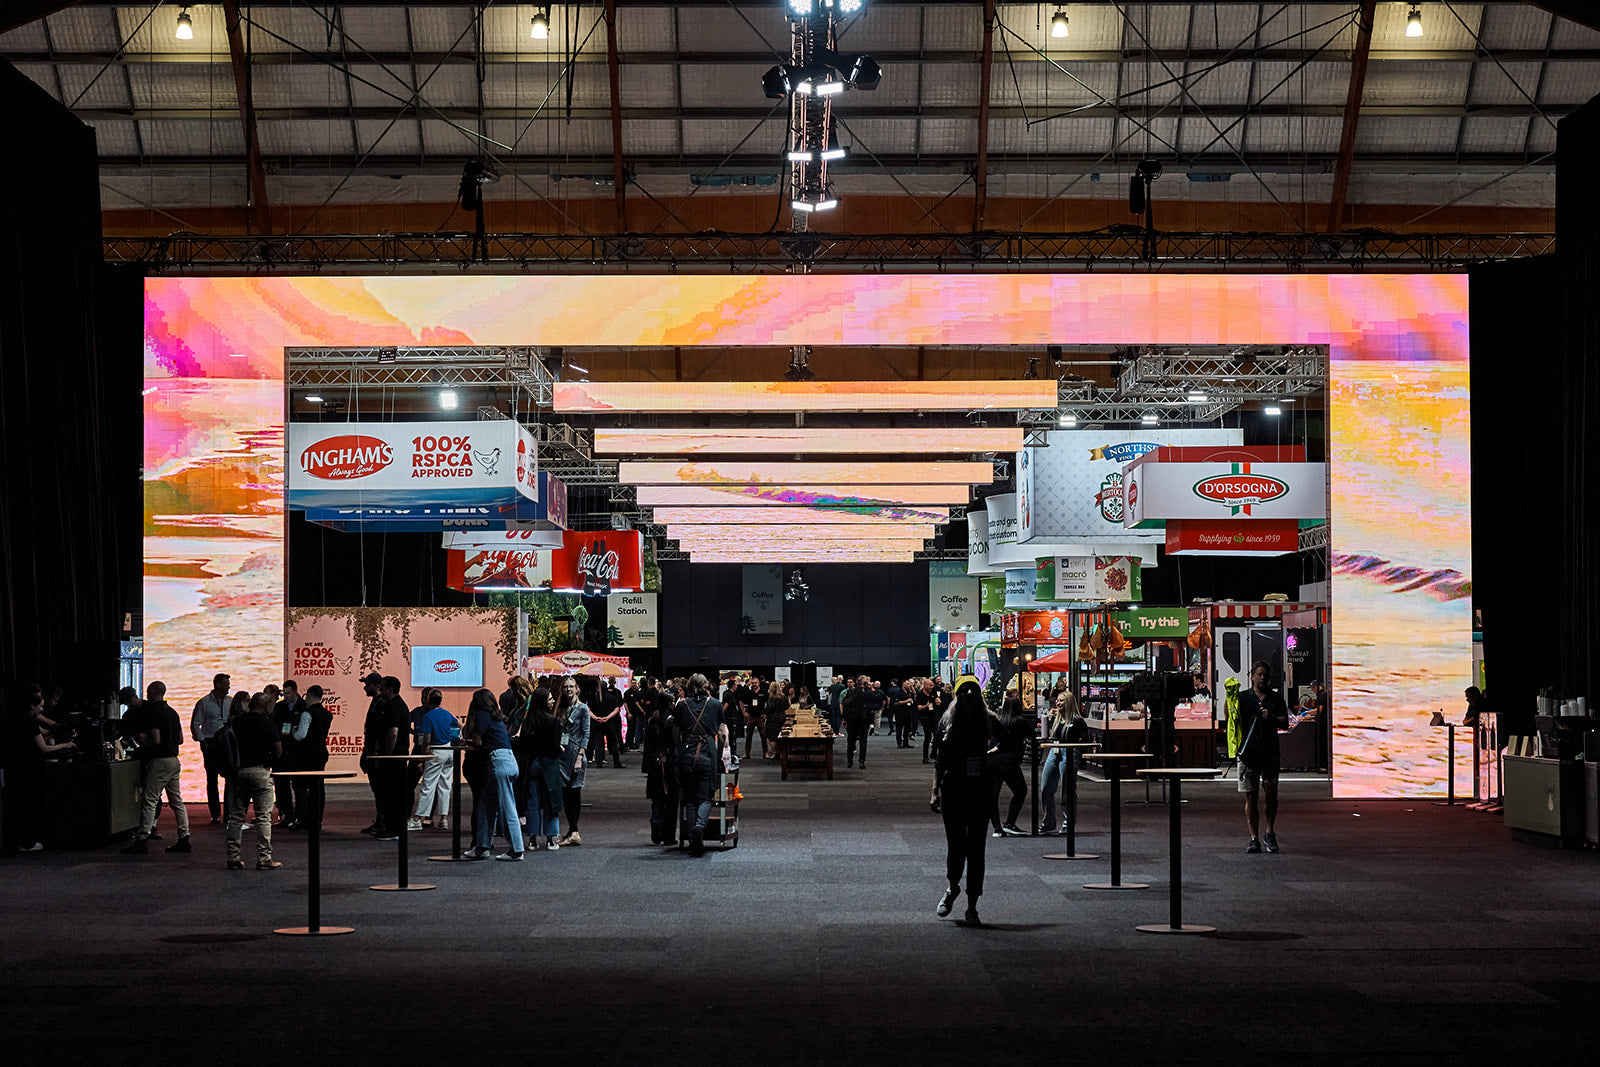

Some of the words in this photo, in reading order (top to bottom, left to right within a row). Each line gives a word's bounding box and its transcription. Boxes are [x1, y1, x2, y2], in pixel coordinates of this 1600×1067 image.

[412, 436, 472, 452] 100%
[303, 443, 394, 472] INGHAM'S
[412, 453, 473, 467] RSPCA
[328, 467, 355, 478] Always
[356, 464, 374, 474] Good
[411, 468, 474, 477] APPROVED
[1204, 483, 1278, 493] D'ORSOGNA
[1102, 489, 1123, 499] BERTOC
[1199, 534, 1232, 545] Supplying
[1246, 535, 1263, 543] since
[1265, 535, 1281, 543] 1959
[941, 595, 968, 603] Coffee
[617, 607, 648, 615] Station
[1139, 617, 1156, 629] Try
[1158, 616, 1180, 627] this
[294, 647, 334, 658] 100%
[294, 659, 335, 669] RSPCA
